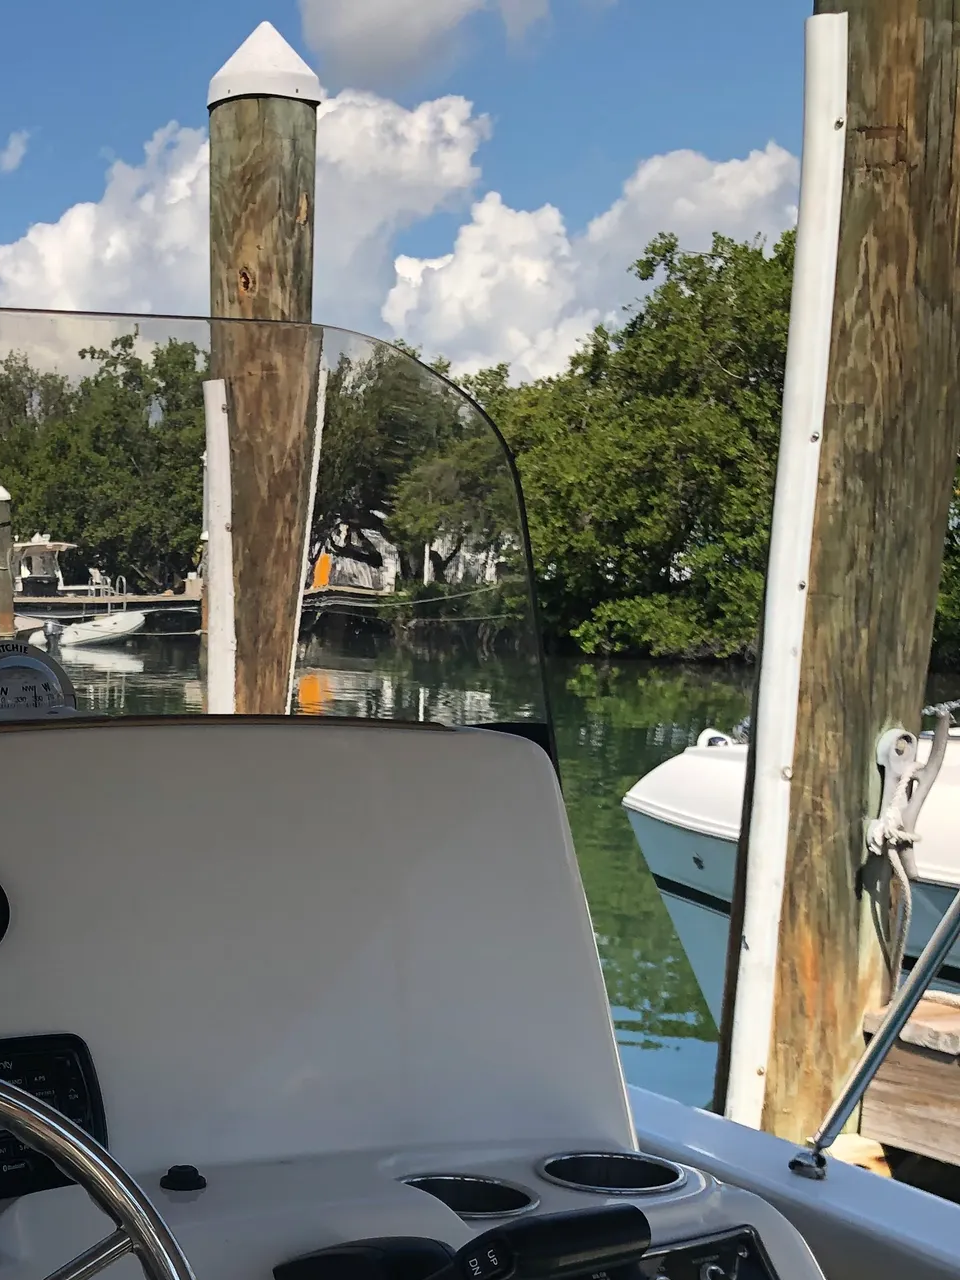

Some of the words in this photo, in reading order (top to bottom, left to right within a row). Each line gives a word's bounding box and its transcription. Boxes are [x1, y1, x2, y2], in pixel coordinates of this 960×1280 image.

[1, 687, 8, 696] N
[487, 1249, 498, 1266] UP
[469, 1258, 482, 1276] DN
